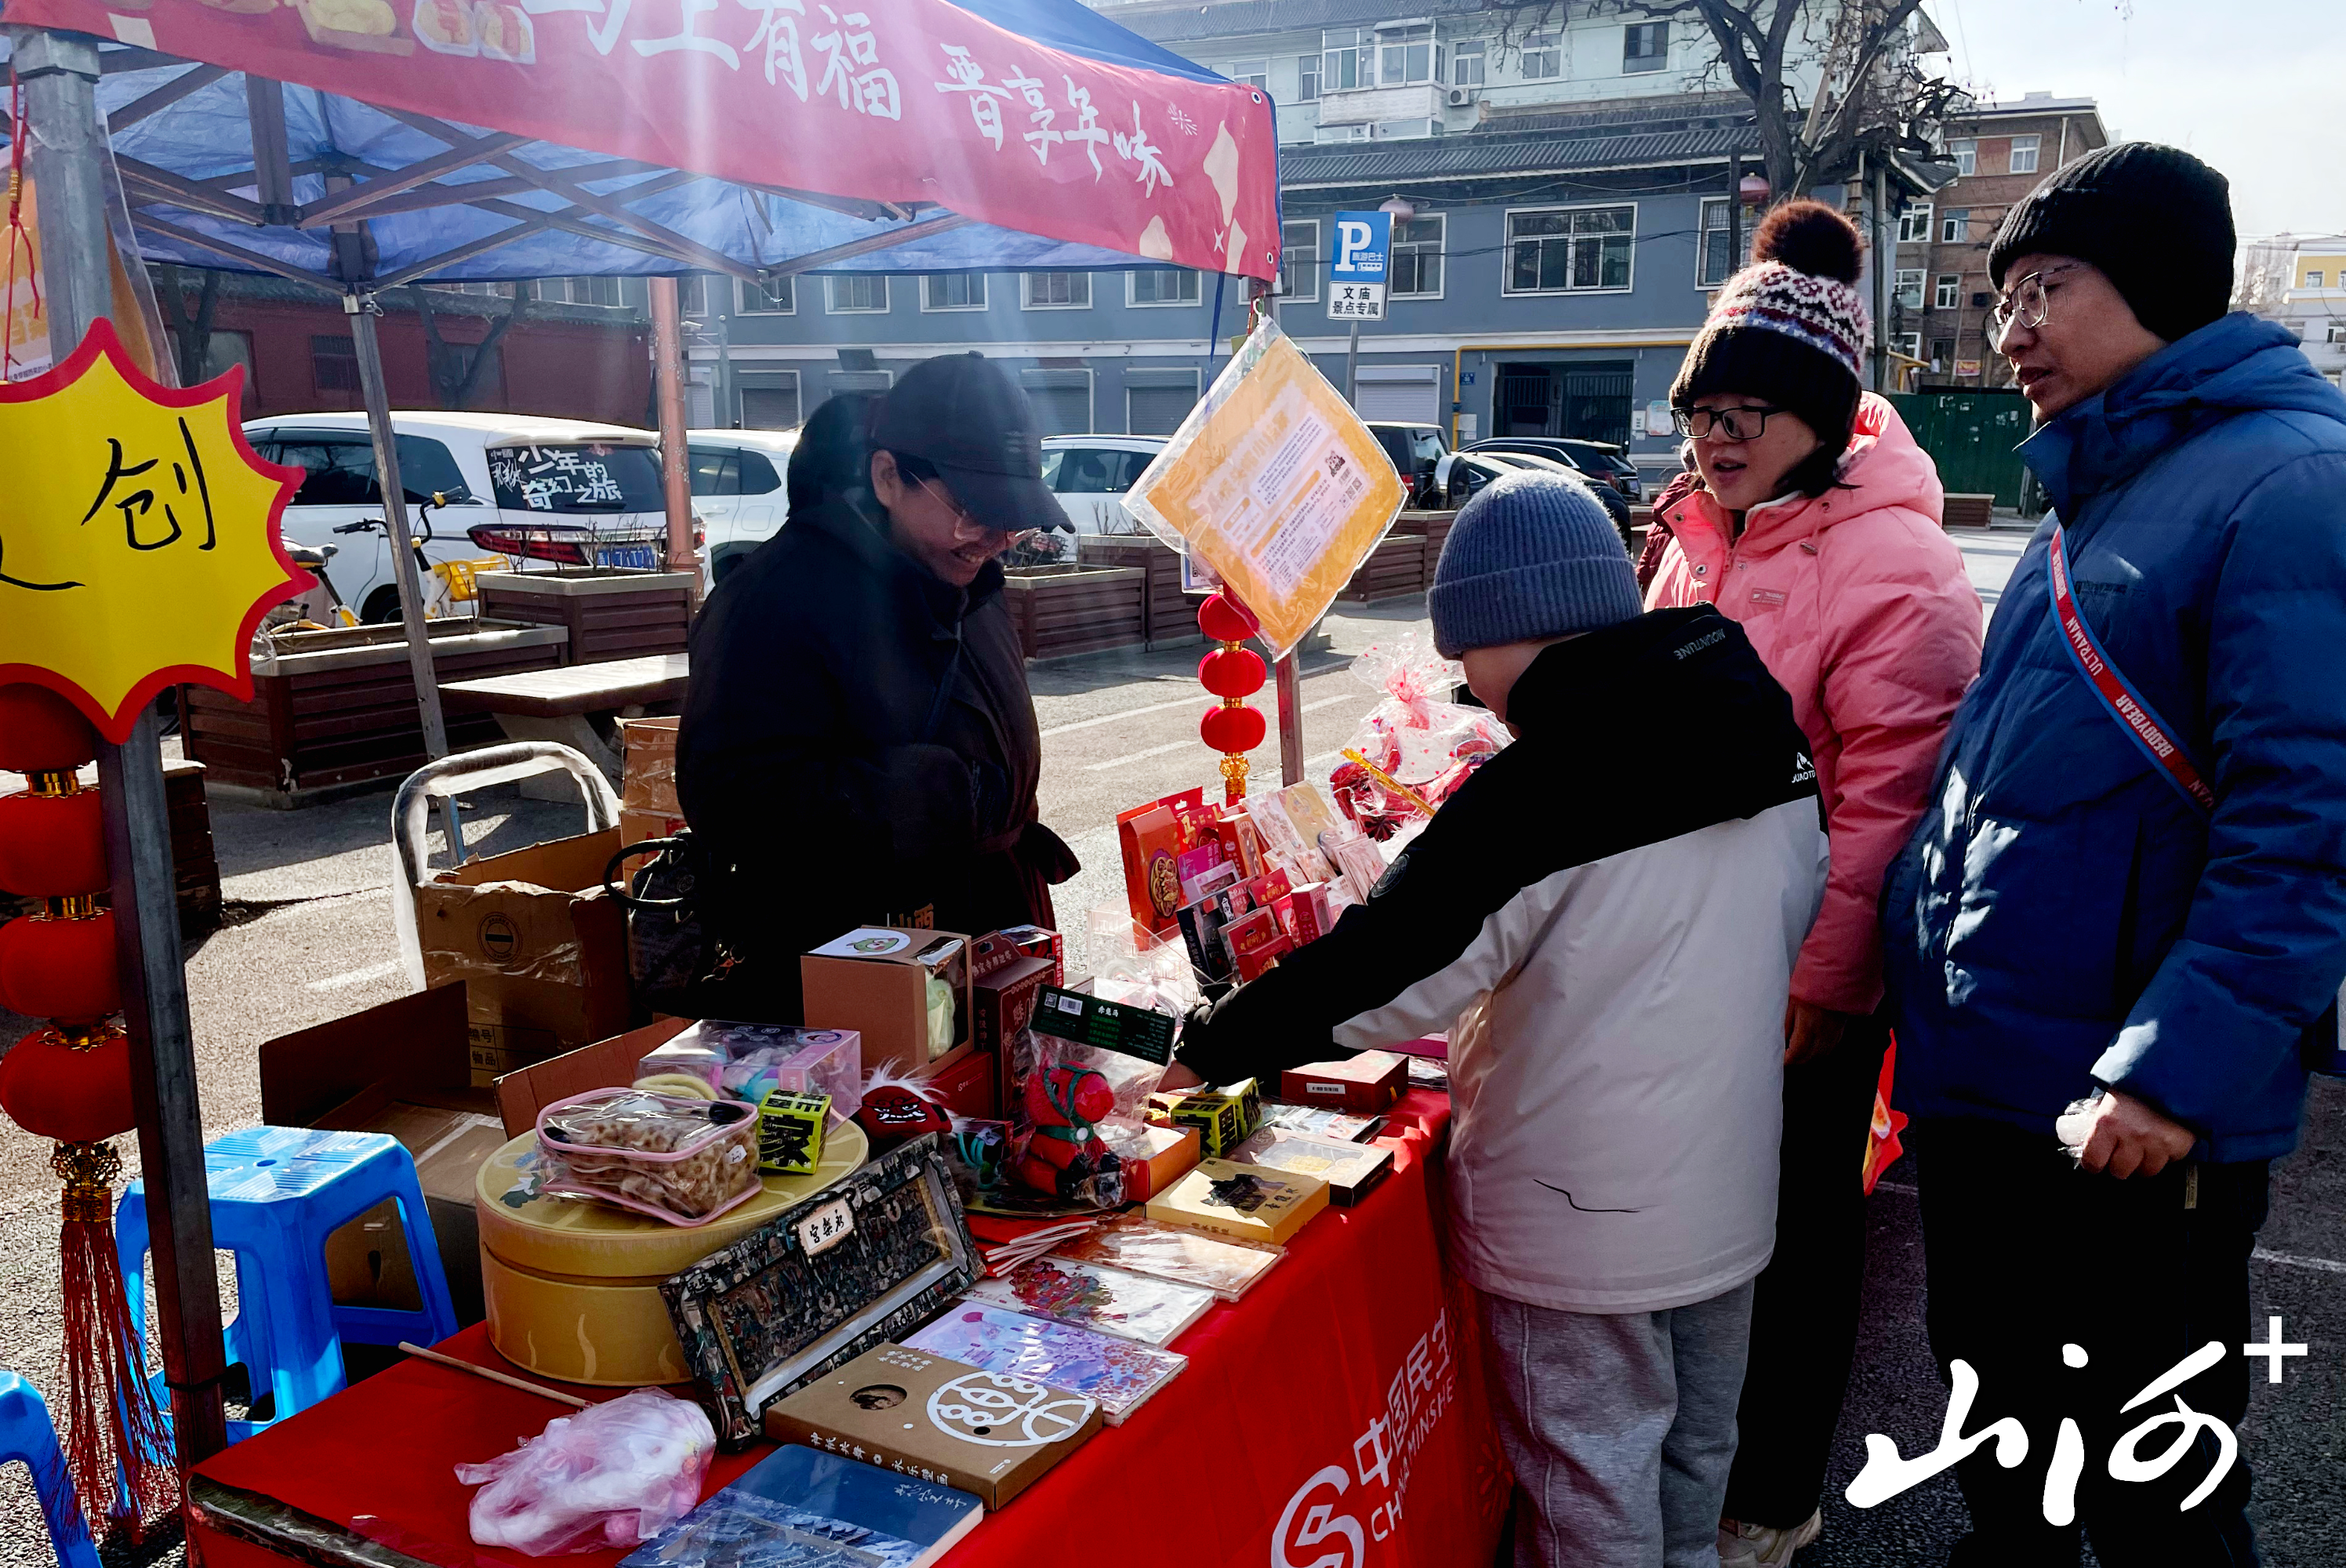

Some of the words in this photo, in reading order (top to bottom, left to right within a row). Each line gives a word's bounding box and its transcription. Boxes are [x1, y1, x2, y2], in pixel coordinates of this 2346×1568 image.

[935, 42, 1174, 198] 晋享年味
[1335, 221, 1372, 271] P
[1352, 252, 1384, 262] 旅游巴士
[1332, 301, 1379, 316] 景点专属
[1343, 286, 1371, 300] 文庙
[518, 445, 608, 479] 少年的
[521, 475, 623, 510] 奇幻之旅
[2065, 616, 2104, 677] ULTRAMAN
[2115, 694, 2174, 758] BEDDYBEAR
[472, 1051, 496, 1067] 物品
[1407, 1374, 1455, 1457] MINSHE
